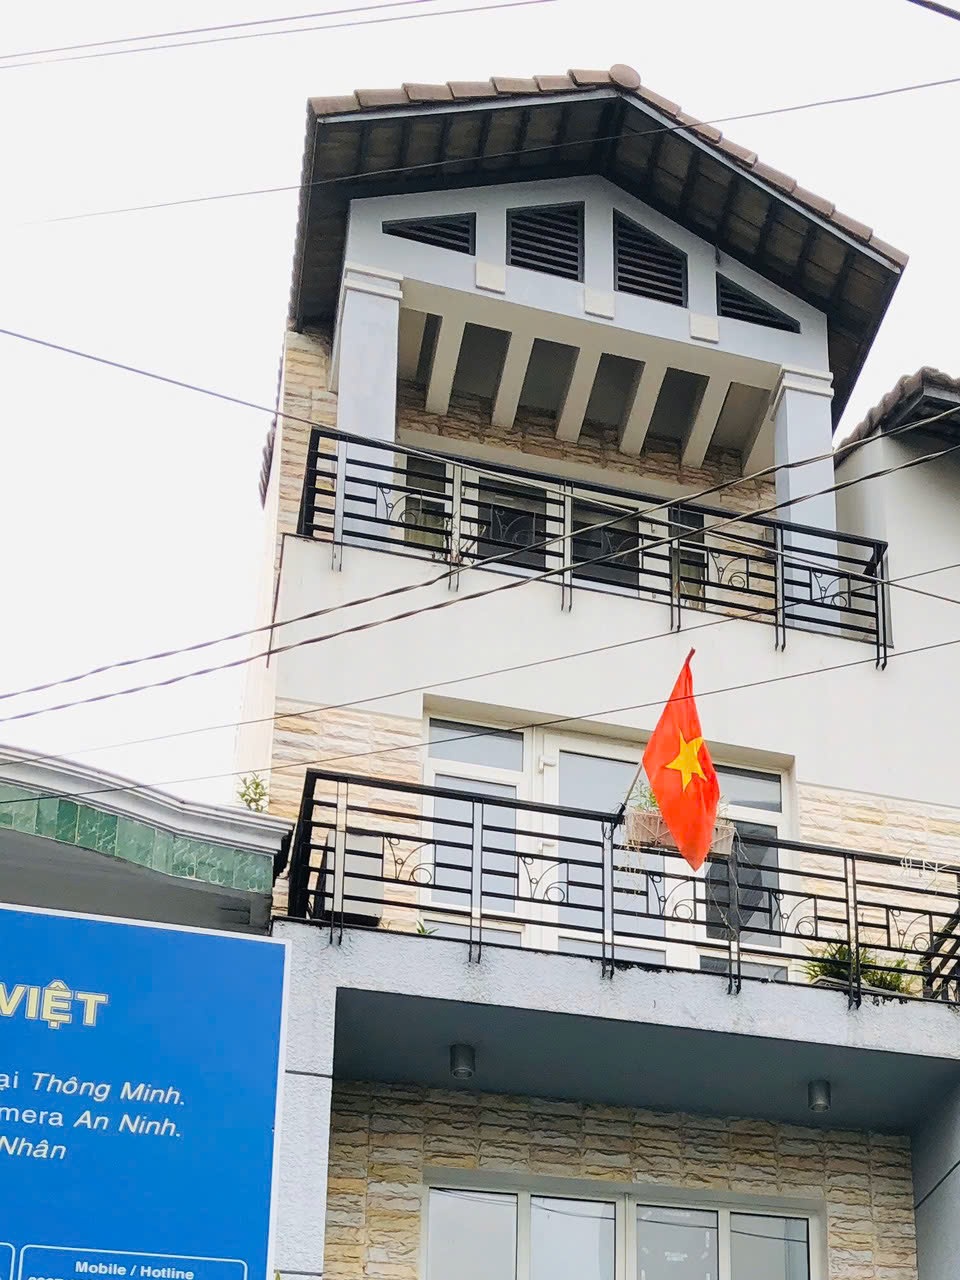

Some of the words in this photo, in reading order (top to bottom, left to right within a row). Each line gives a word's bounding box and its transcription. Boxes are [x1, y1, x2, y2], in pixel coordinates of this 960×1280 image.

[0, 979, 109, 1030] VIỆT
[32, 1072, 111, 1102] Thông
[119, 1081, 185, 1106] Minh.
[0, 1106, 64, 1127] mera
[73, 1110, 109, 1130] An
[118, 1114, 181, 1137] Ninh.
[0, 1135, 66, 1160] Nhân
[75, 1261, 127, 1276] Mobile
[129, 1264, 137, 1276] /
[140, 1266, 195, 1280] Hotline
